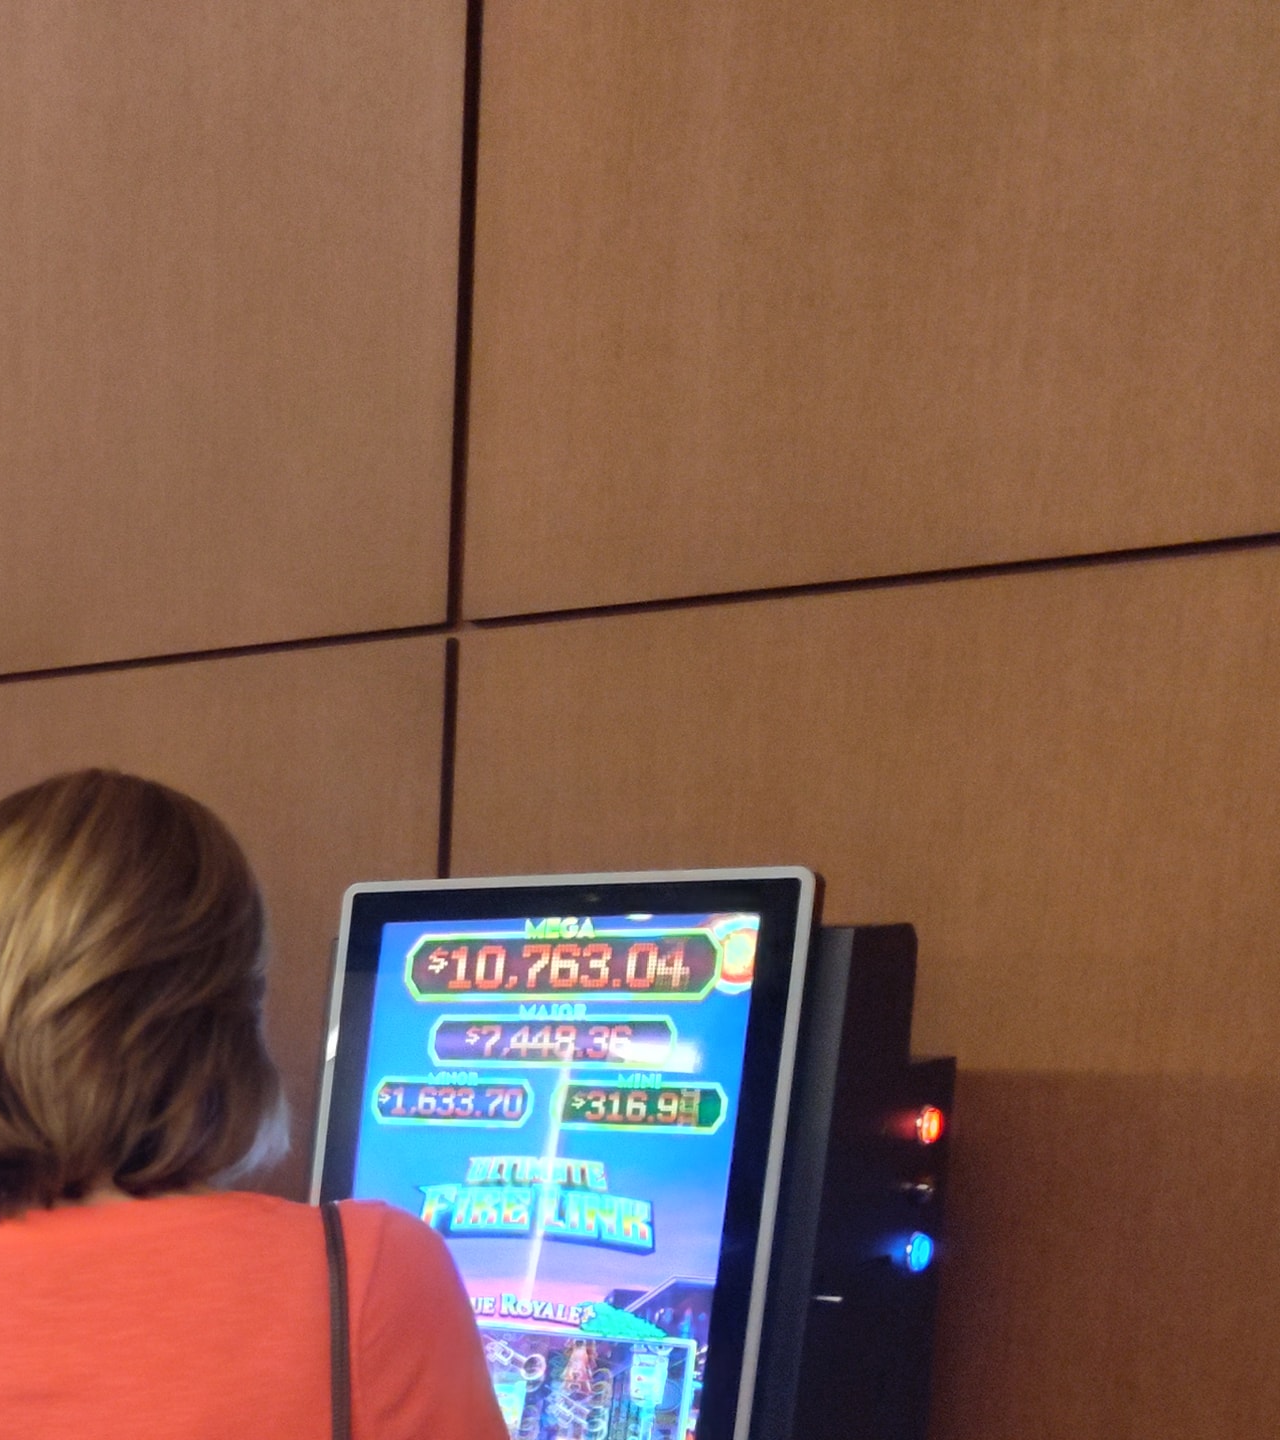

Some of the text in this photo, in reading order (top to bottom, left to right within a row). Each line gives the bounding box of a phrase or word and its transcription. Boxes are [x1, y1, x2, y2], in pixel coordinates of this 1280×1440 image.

[524, 917, 595, 939] MEGA
[428, 942, 689, 990] $10,763.04
[519, 1003, 588, 1021] MAJOR
[428, 1072, 480, 1087] MINOR
[618, 1073, 662, 1090] MINI
[533, 1184, 654, 1250] LINK
